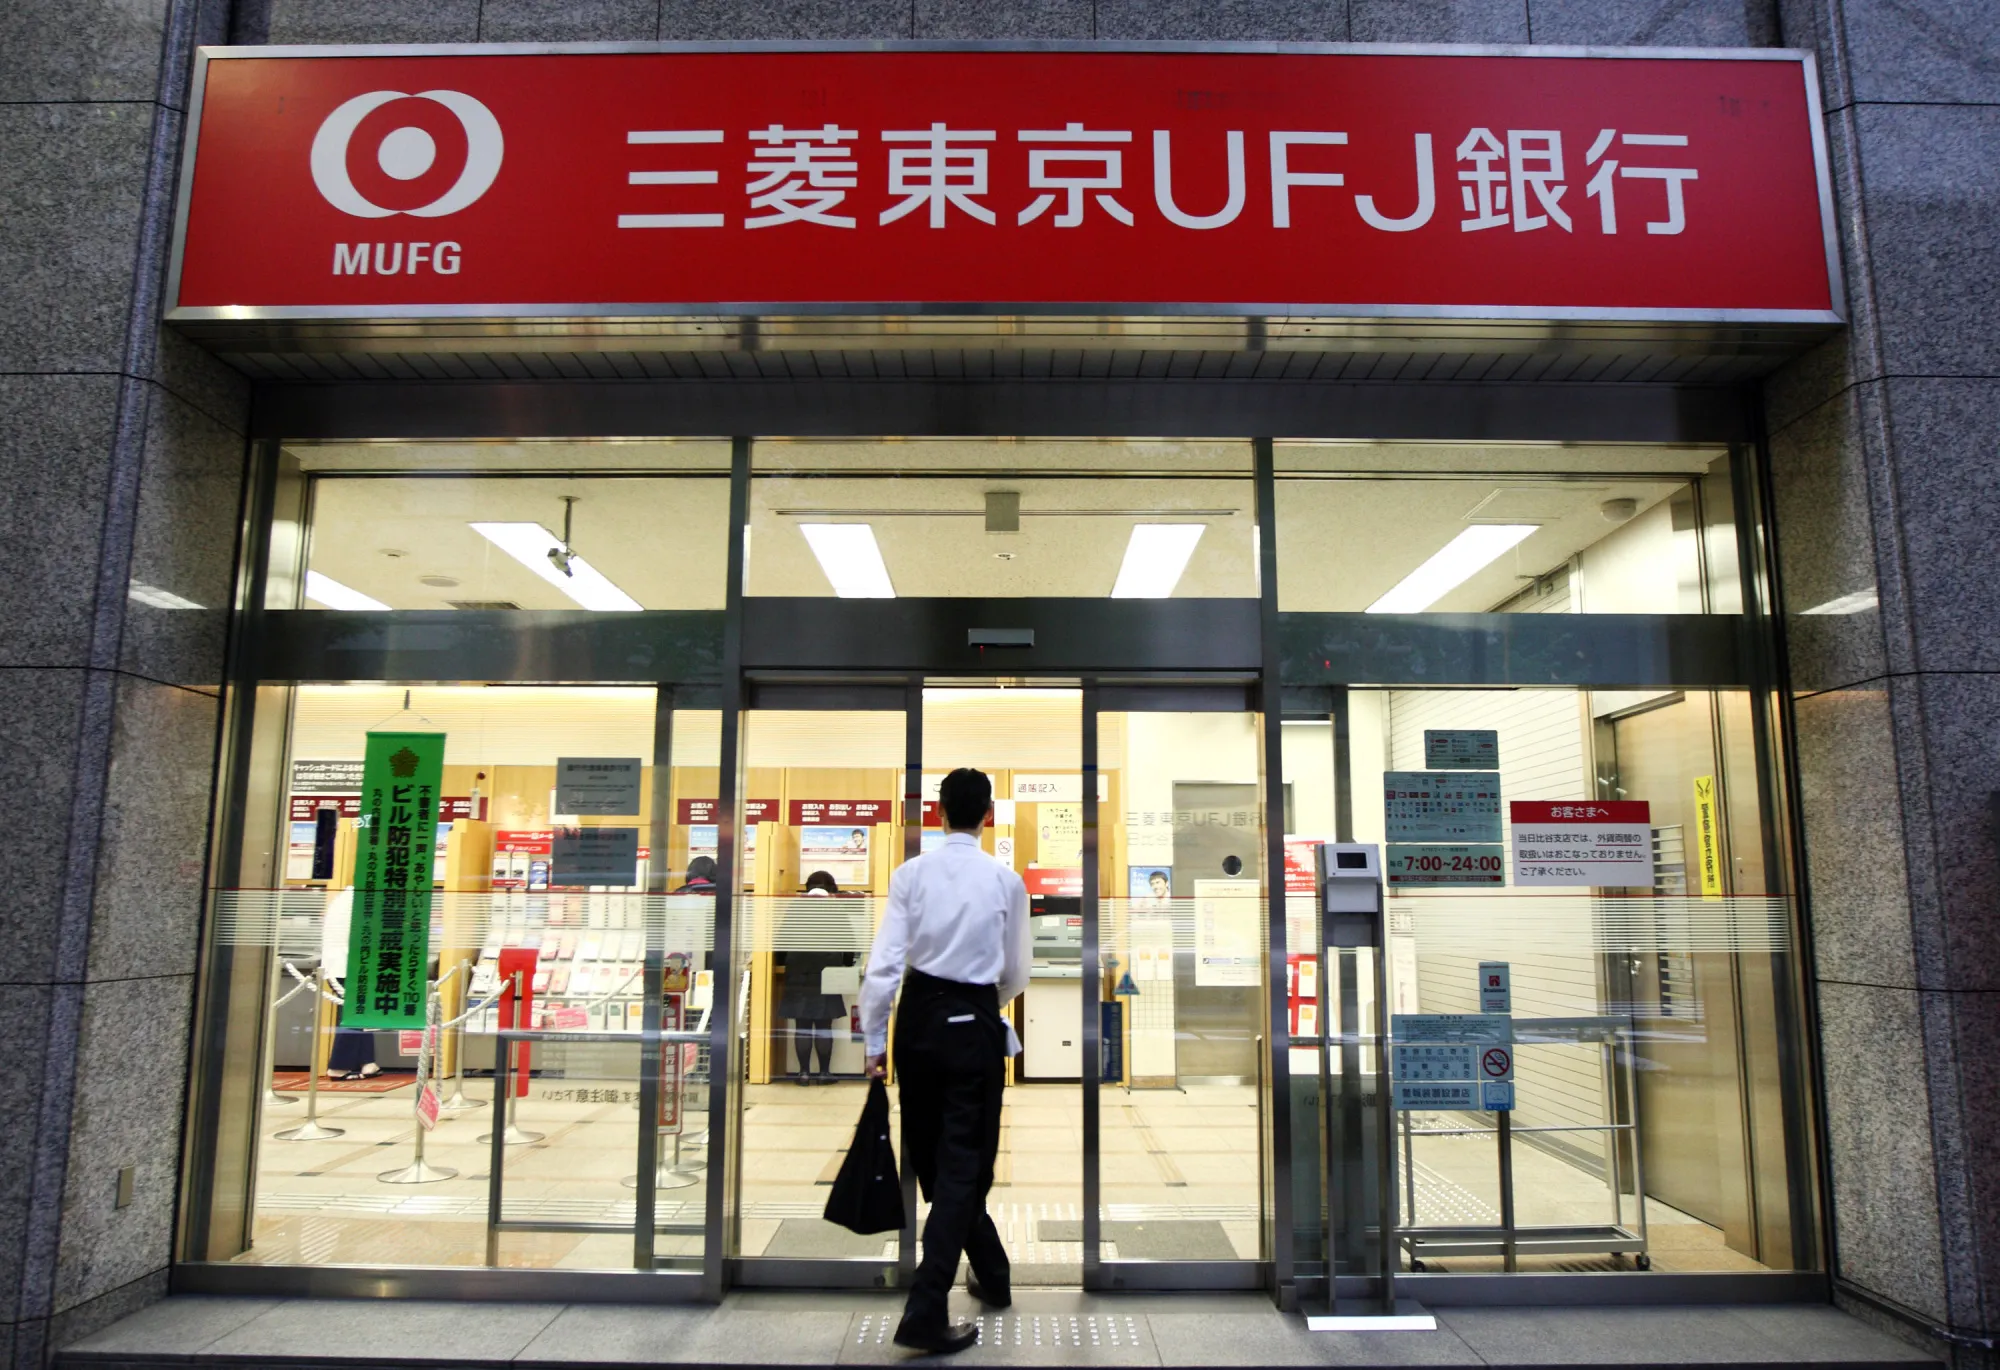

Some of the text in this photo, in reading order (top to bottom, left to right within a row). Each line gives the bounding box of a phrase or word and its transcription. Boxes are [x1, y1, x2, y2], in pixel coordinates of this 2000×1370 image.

[617, 122, 1699, 235] 三菱東京UFJ銀行
[332, 241, 462, 276] MUFG
[1017, 783, 1058, 793] 通帳記入
[1550, 806, 1609, 818] お客さまへ
[1518, 833, 1641, 843] 当日比谷支店では、外貨両替の
[1519, 849, 1646, 859] 取扱いはおこなっておりません。
[1520, 866, 1586, 876] ご了承ください。
